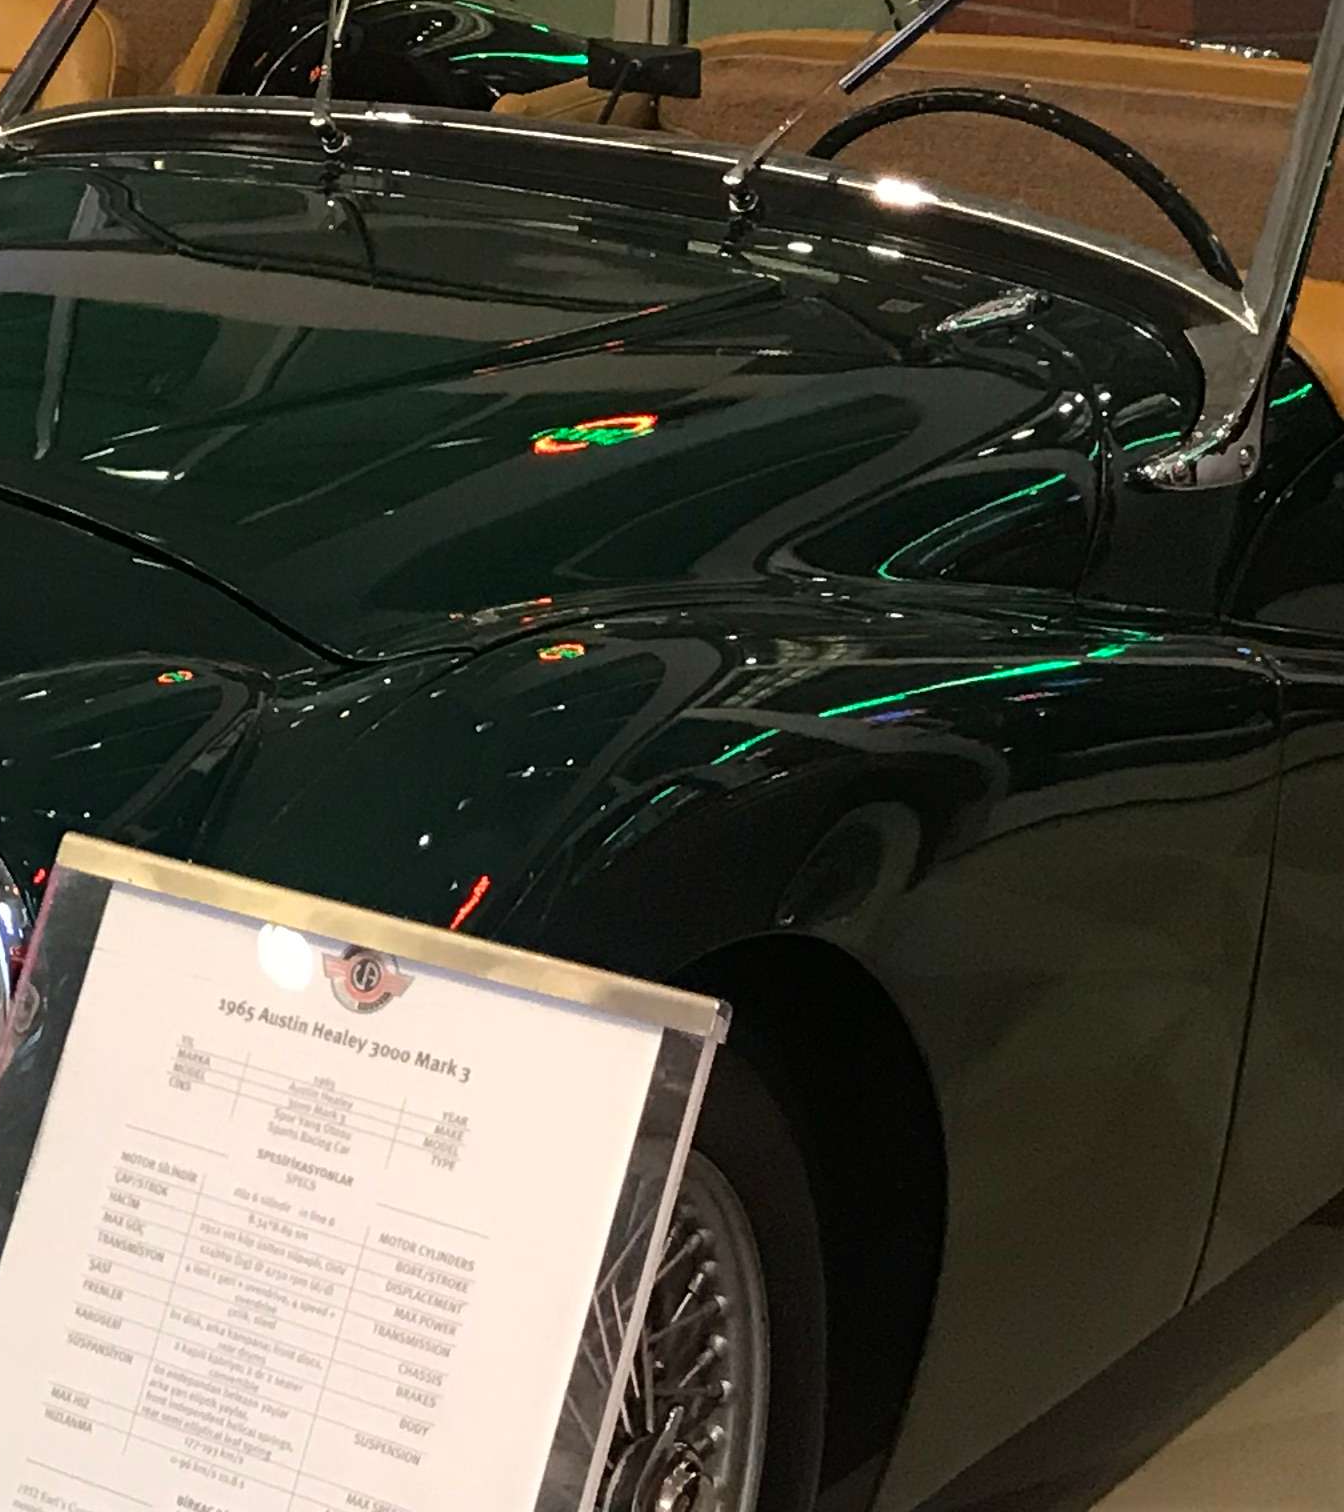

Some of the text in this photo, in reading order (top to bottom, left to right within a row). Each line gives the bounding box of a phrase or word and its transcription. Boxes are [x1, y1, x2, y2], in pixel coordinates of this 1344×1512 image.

[218, 998, 472, 1083] 1965 Austin Healey 3000 Mark 3
[378, 1232, 476, 1273] MOTOR CYLINDERS
[385, 1279, 464, 1315] DISPLACEMENT
[372, 1322, 452, 1358] TRANSMISSION
